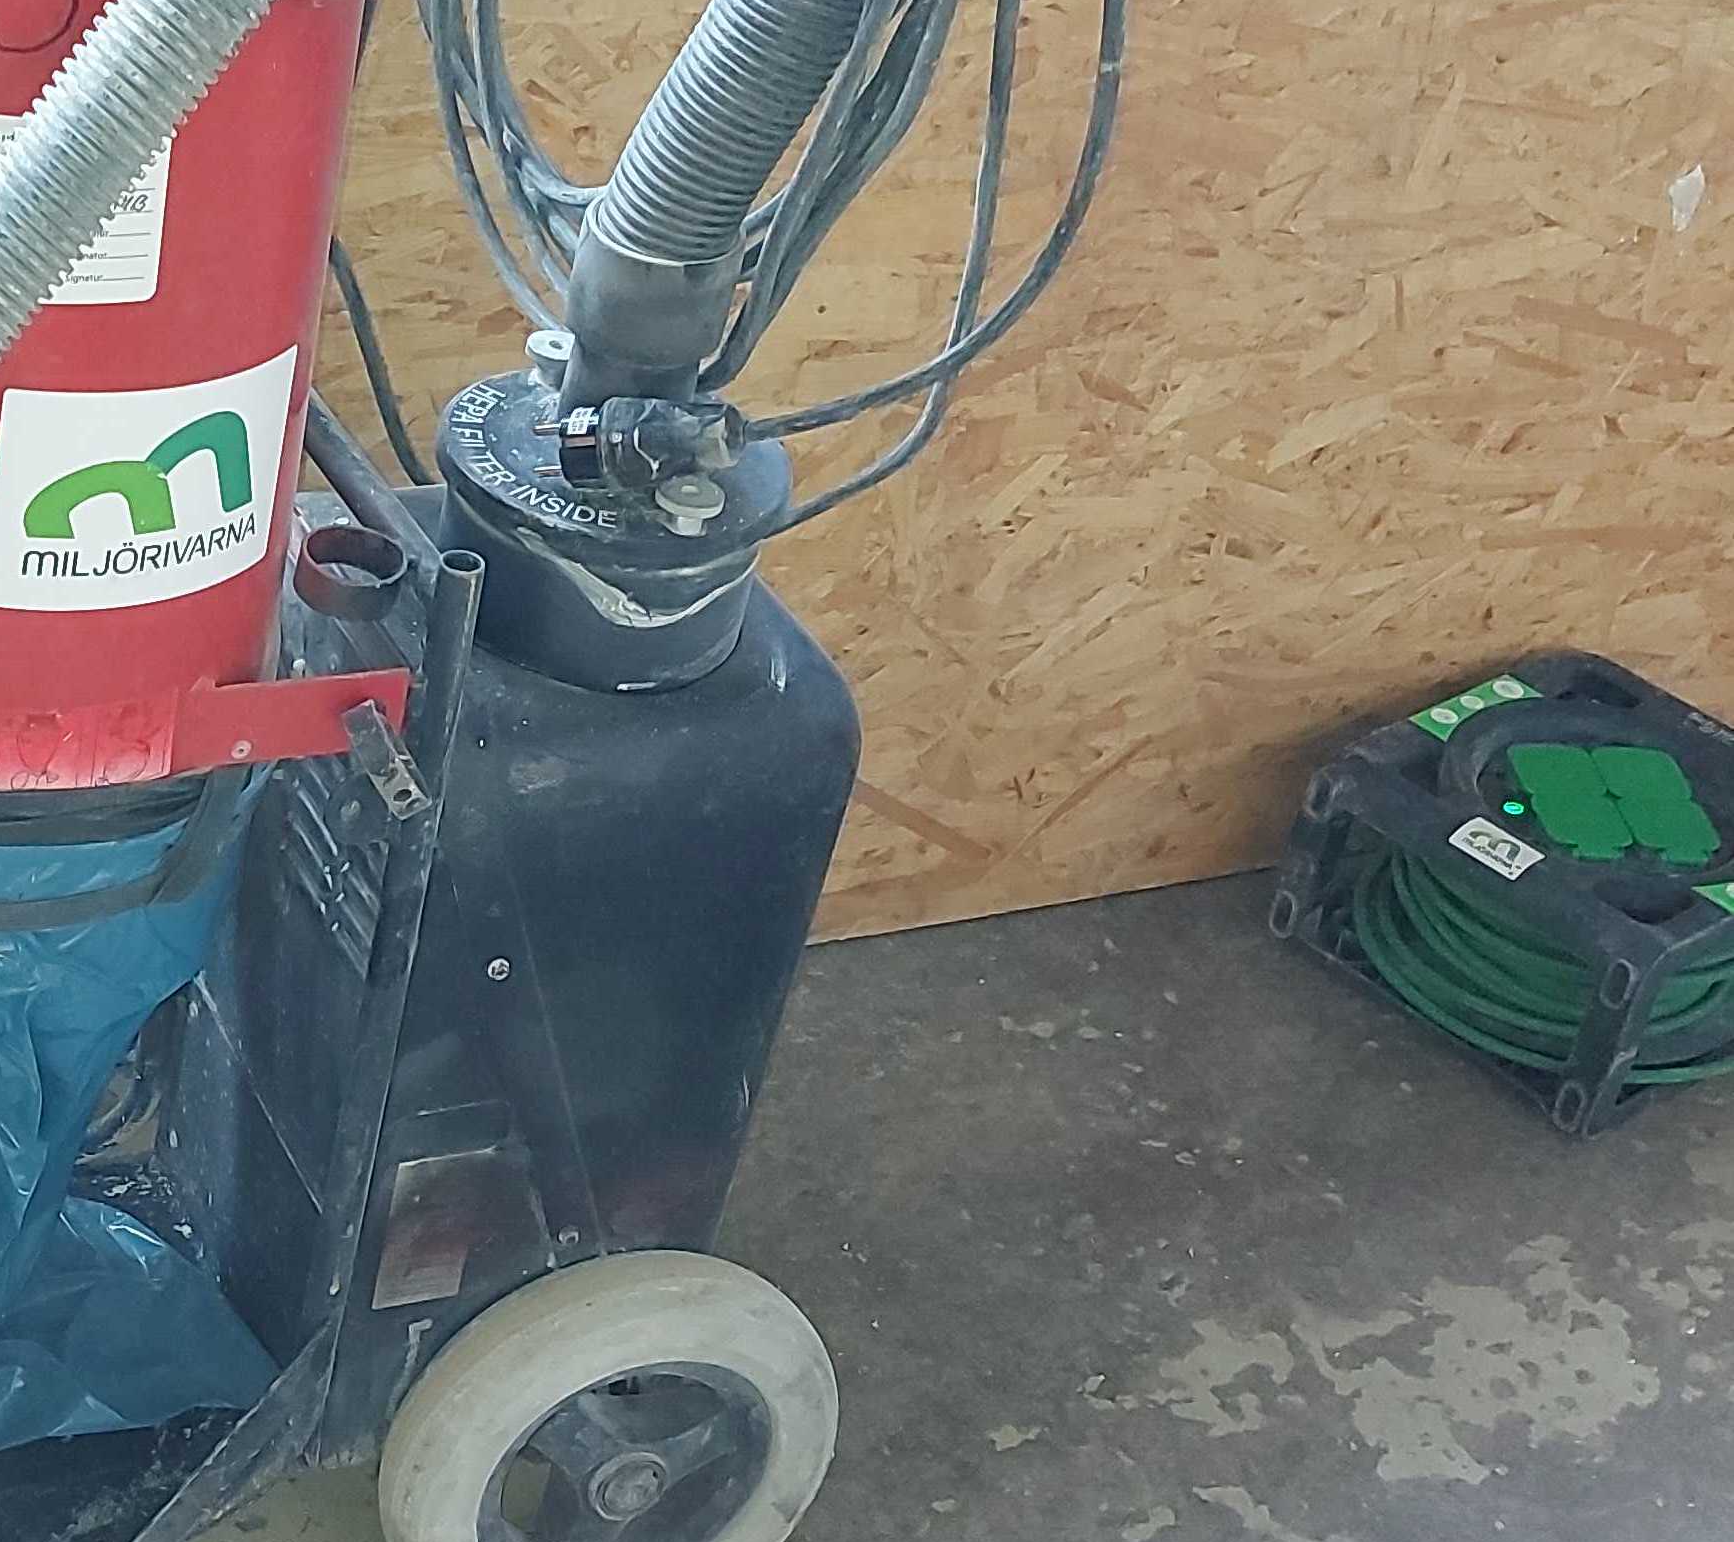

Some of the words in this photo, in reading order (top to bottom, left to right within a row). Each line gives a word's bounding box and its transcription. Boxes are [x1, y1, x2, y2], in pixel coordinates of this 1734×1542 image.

[450, 384, 507, 425] HEPA
[450, 426, 516, 486] FILTER
[508, 484, 619, 529] INSIDE
